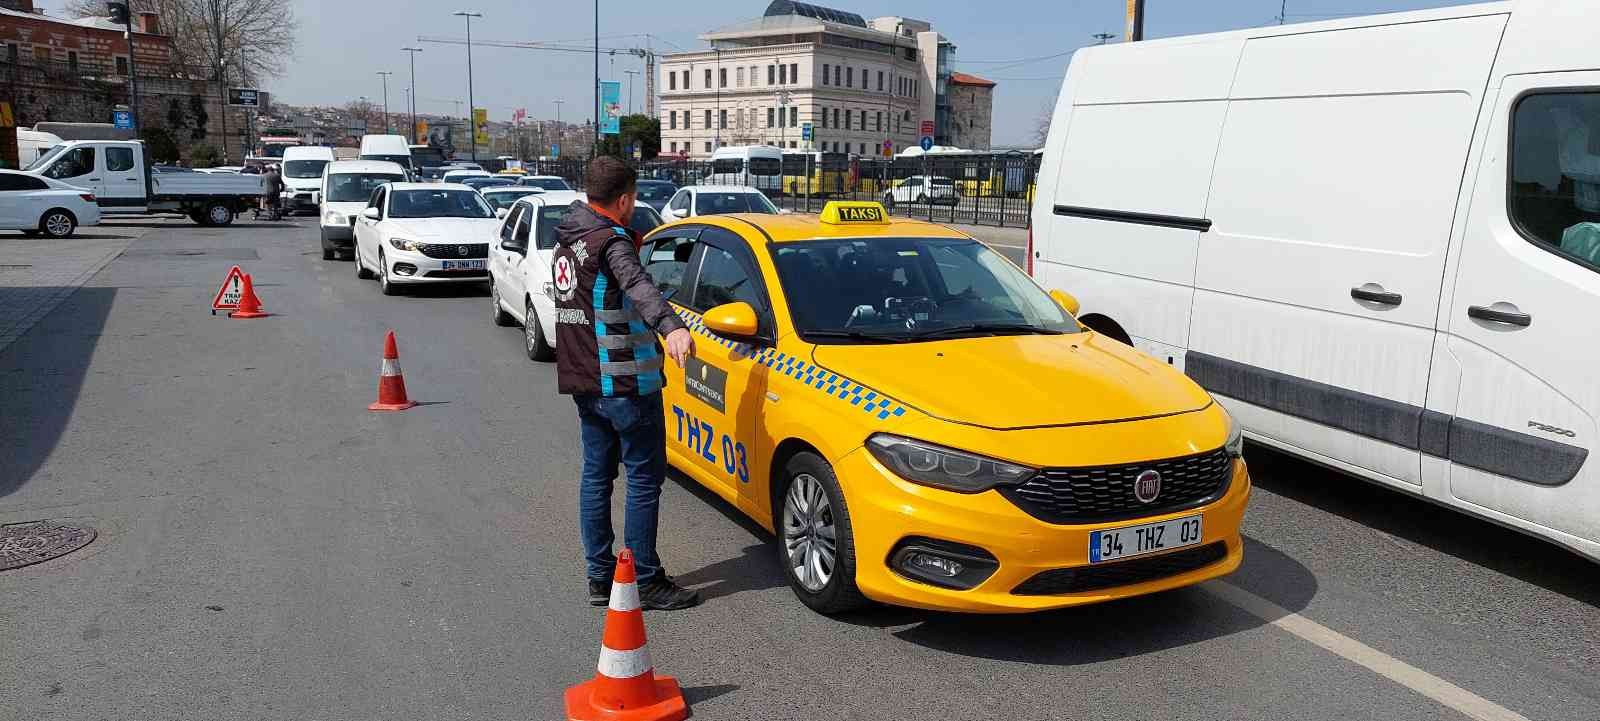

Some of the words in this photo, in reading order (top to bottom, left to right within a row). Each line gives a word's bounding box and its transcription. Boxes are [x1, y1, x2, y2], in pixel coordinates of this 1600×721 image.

[672, 405, 715, 464] THZ
[722, 434, 749, 483] 03
[1141, 480, 1157, 495] FIAT
[1103, 533, 1123, 556] 34
[1136, 525, 1165, 551] THZ
[1181, 520, 1199, 543] 03
